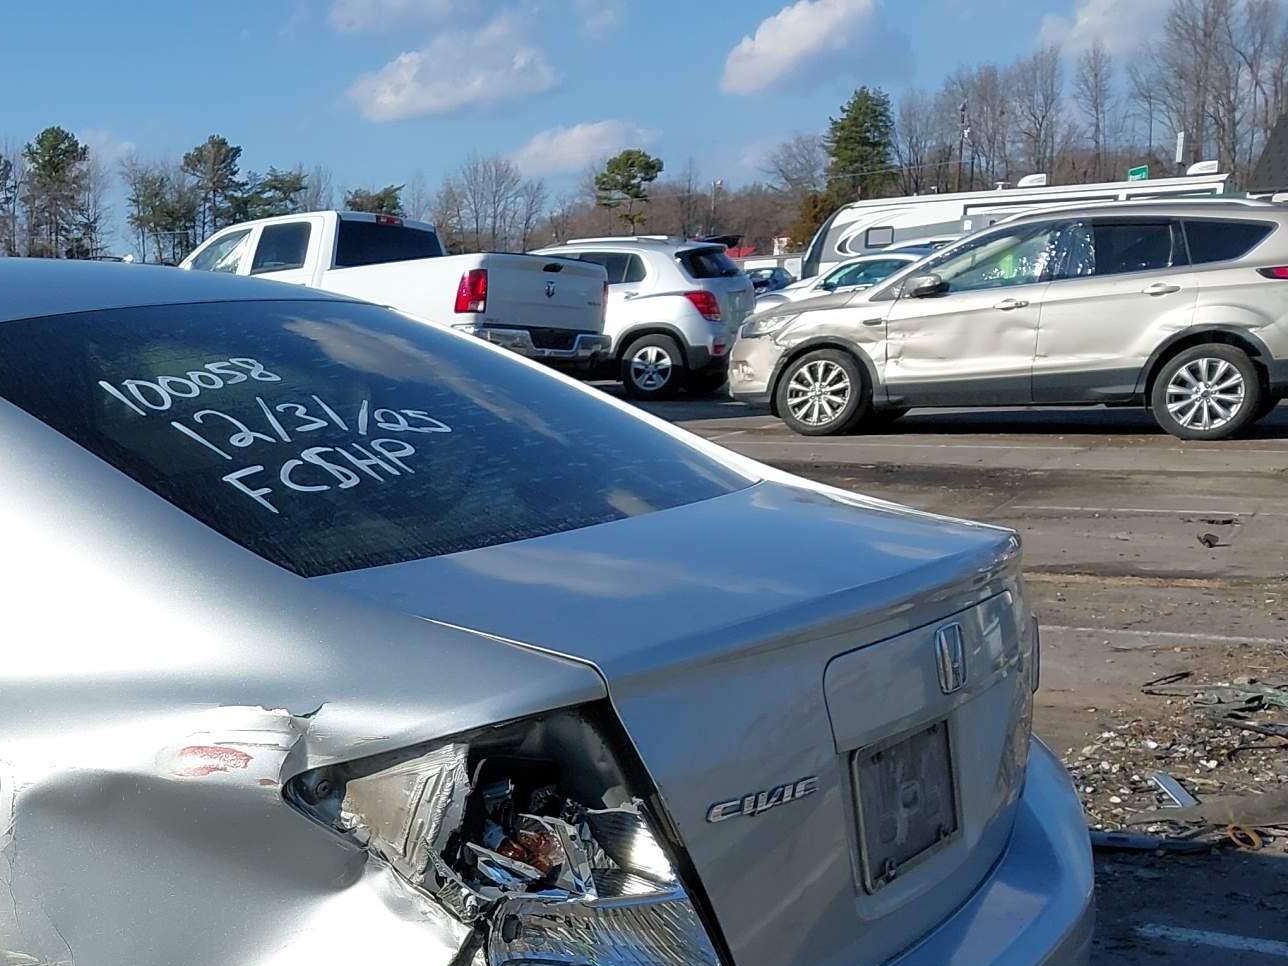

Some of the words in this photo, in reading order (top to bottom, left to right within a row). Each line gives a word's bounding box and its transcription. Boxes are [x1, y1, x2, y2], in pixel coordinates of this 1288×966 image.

[99, 358, 282, 417] 100058
[170, 395, 453, 460] 12/31/25
[706, 775, 819, 823] CIVIC
